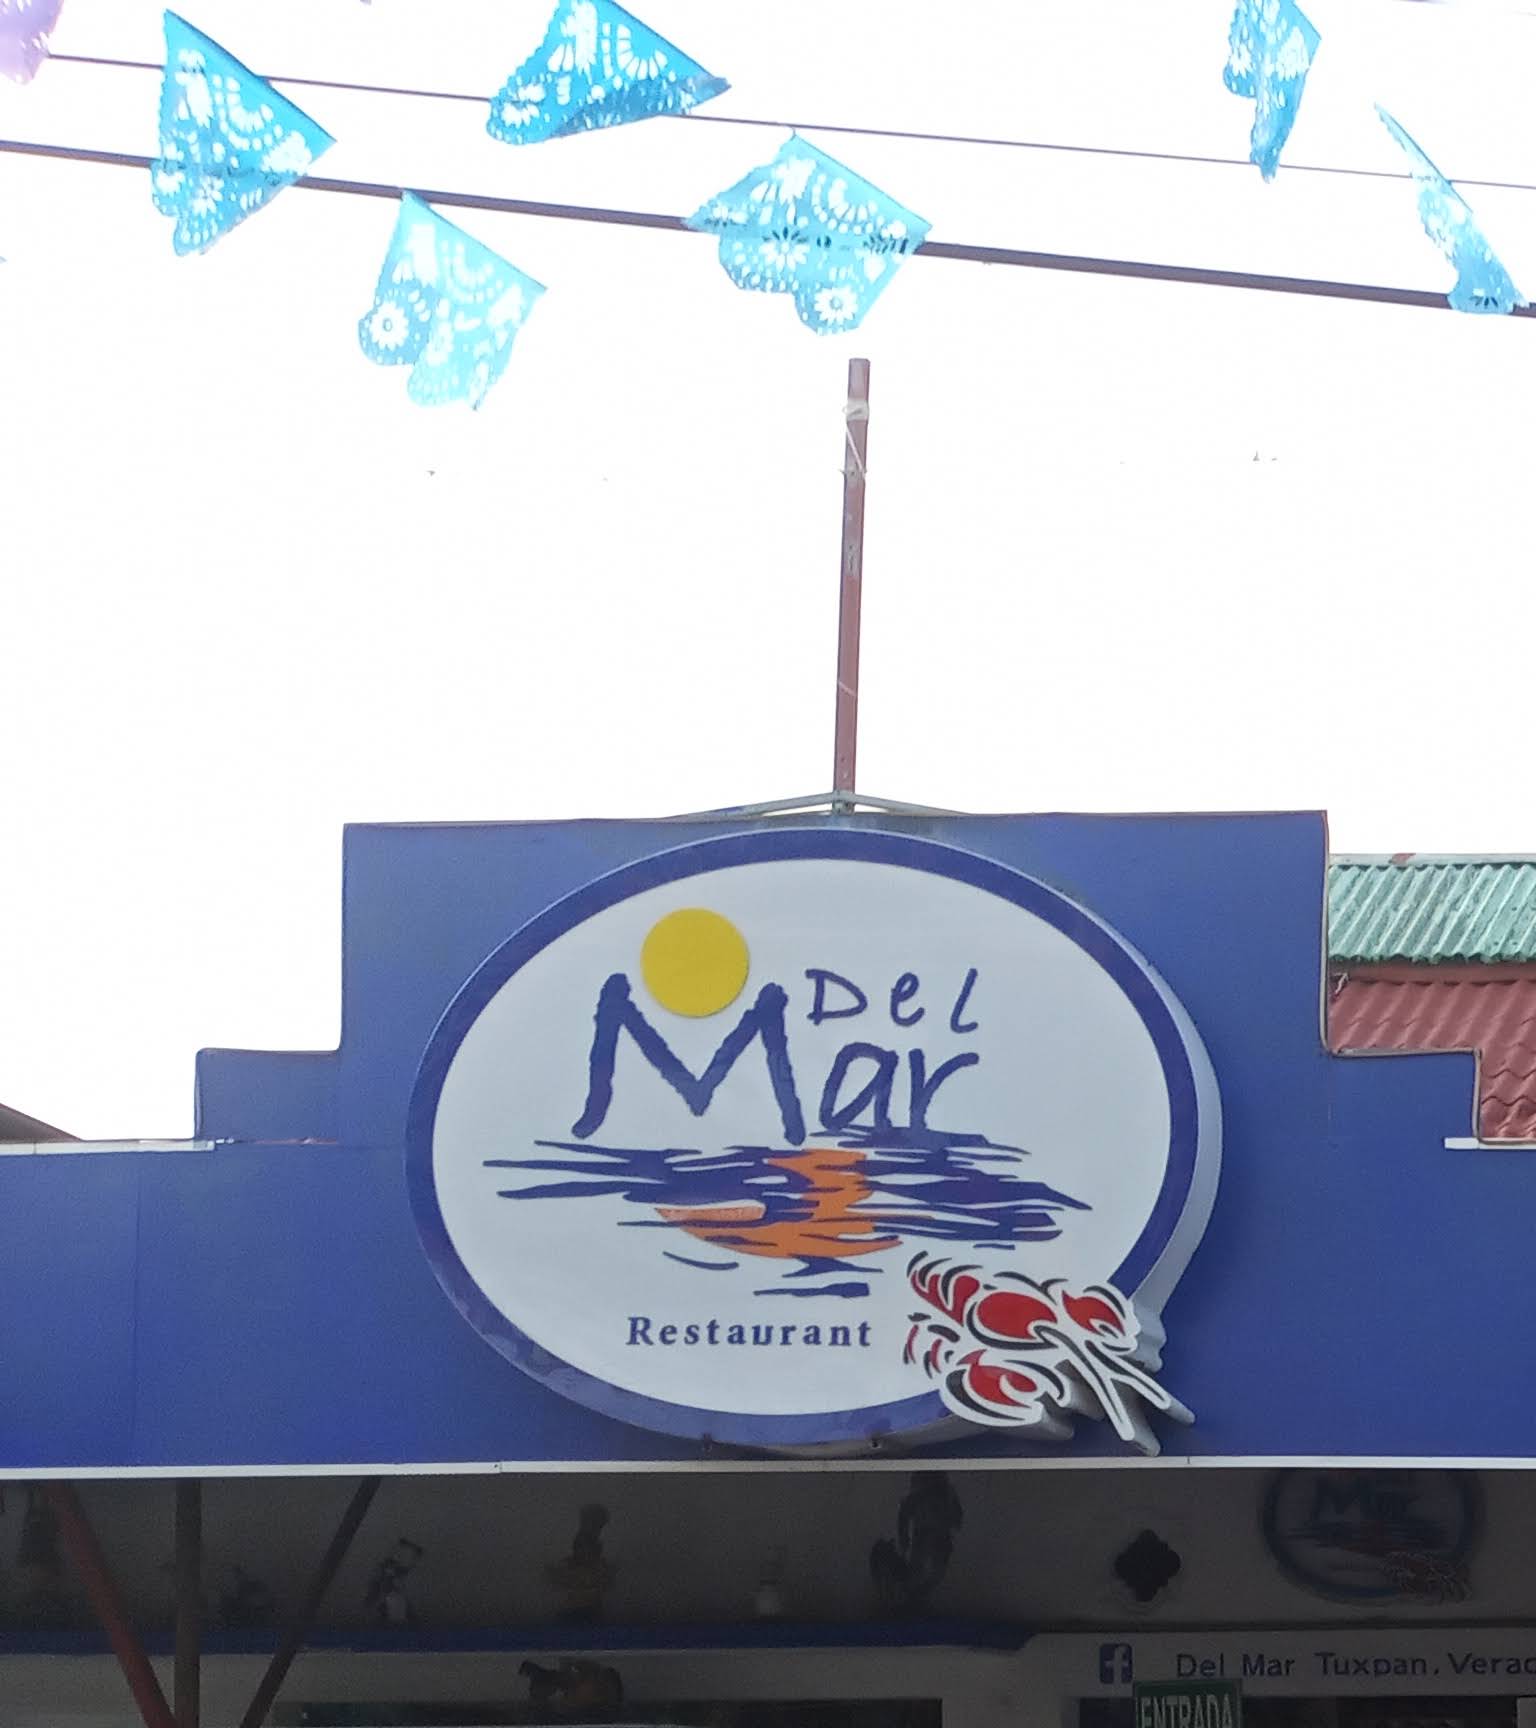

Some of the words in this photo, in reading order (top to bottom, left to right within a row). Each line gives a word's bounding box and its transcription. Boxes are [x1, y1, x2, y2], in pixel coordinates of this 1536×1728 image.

[571, 972, 980, 1146] Mar
[625, 1315, 873, 1348] Restaurant
[1176, 1653, 1225, 1678] Del
[1242, 1654, 1296, 1679] Mar
